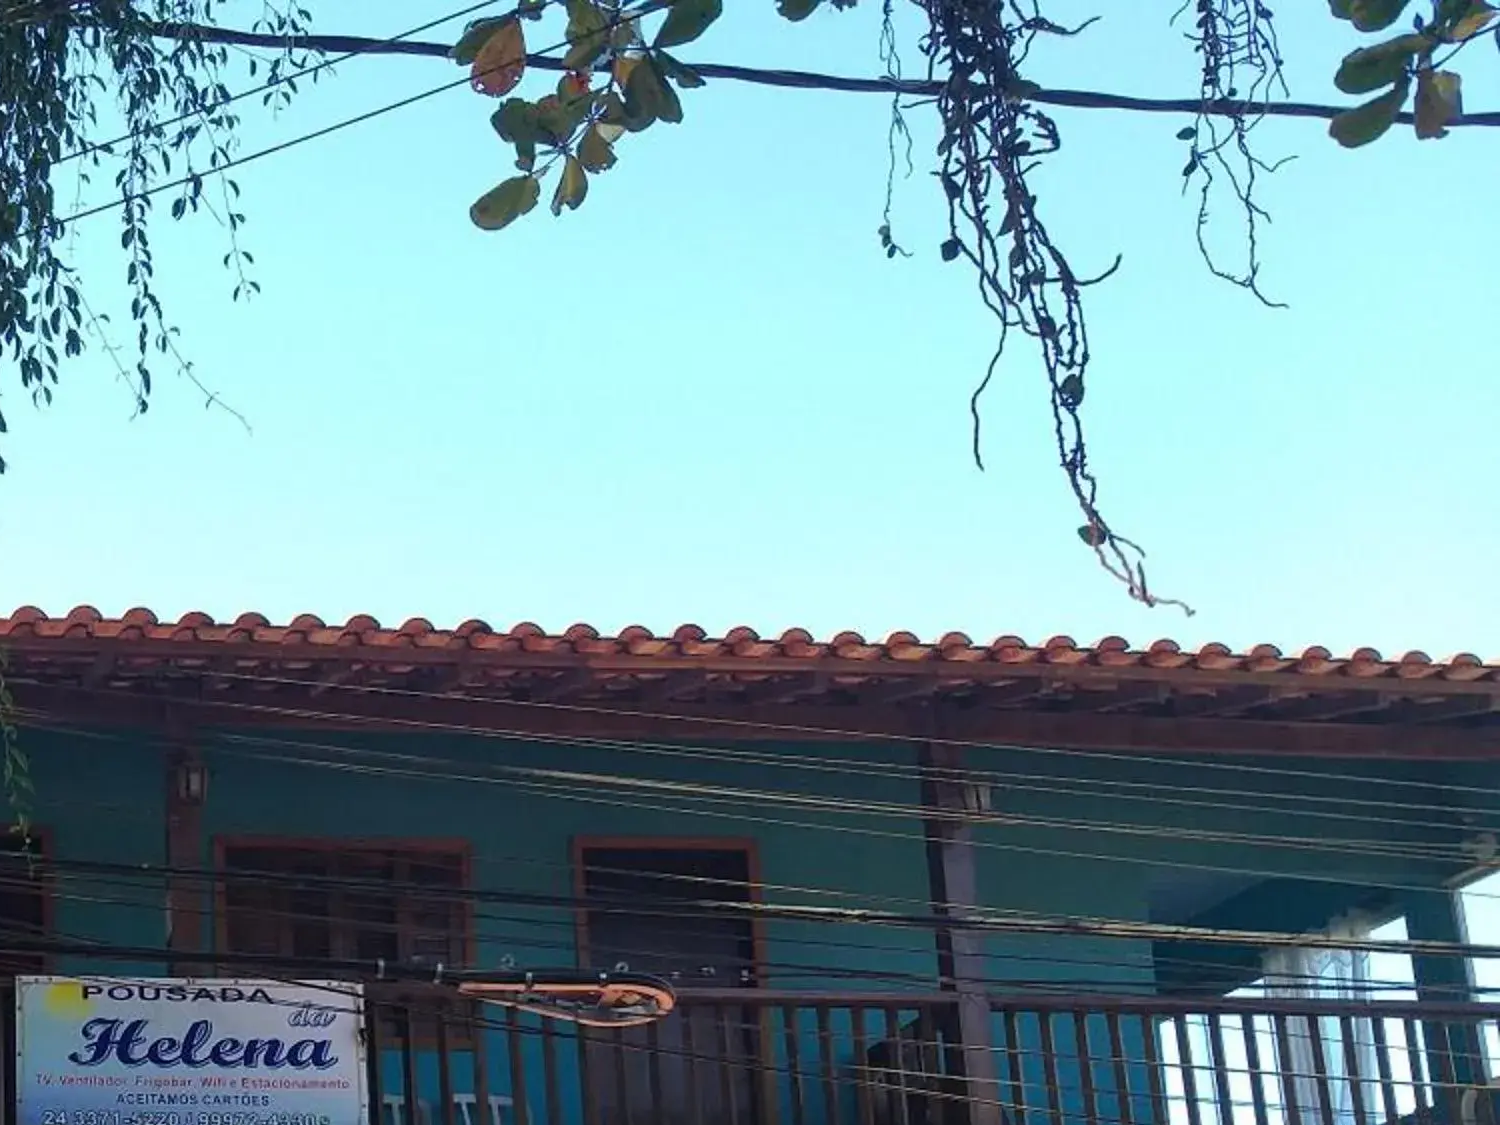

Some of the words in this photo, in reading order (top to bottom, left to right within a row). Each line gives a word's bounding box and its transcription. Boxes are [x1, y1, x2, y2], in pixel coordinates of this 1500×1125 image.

[81, 985, 275, 1003] POUSADA
[287, 1008, 336, 1028] da
[68, 1015, 340, 1070] Helena
[241, 1076, 350, 1091] Estacionamento
[116, 1094, 198, 1107] ACEITAMOS
